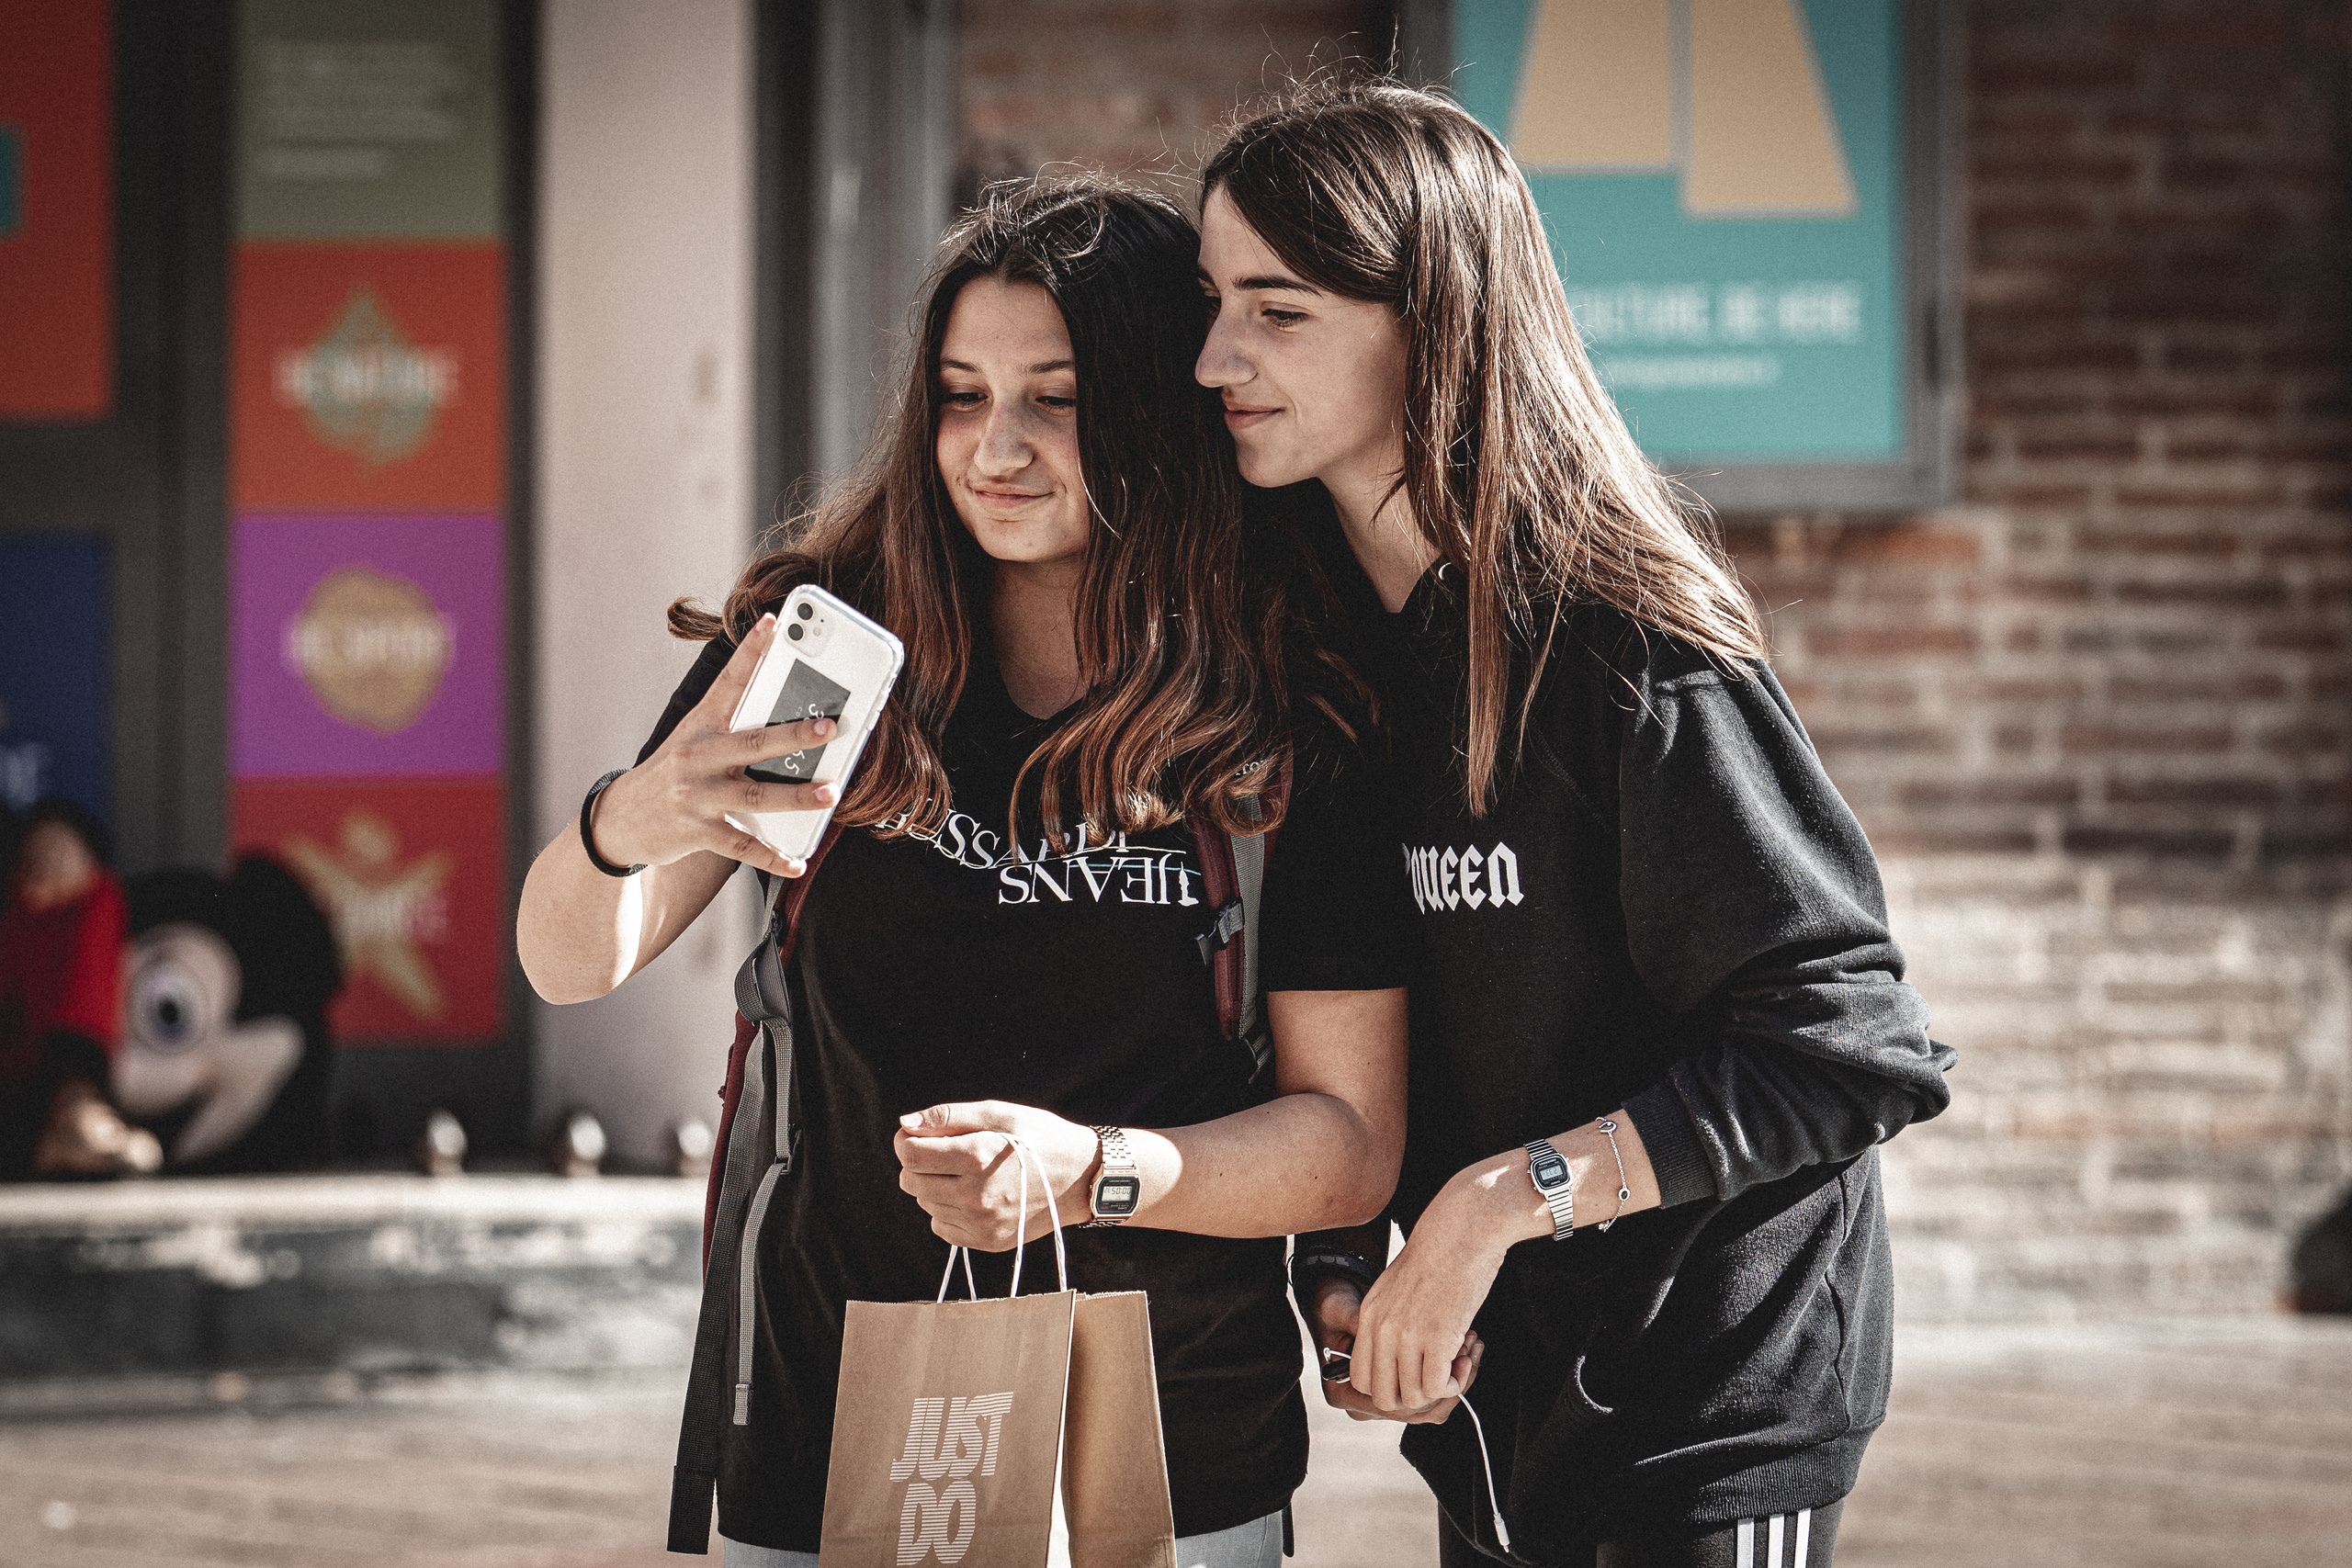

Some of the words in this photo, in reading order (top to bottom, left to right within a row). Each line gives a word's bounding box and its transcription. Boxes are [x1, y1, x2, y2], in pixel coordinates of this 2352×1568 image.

[999, 852, 1173, 905] JEANS
[889, 1391, 1014, 1483] JUST
[896, 1479, 977, 1567] DO
